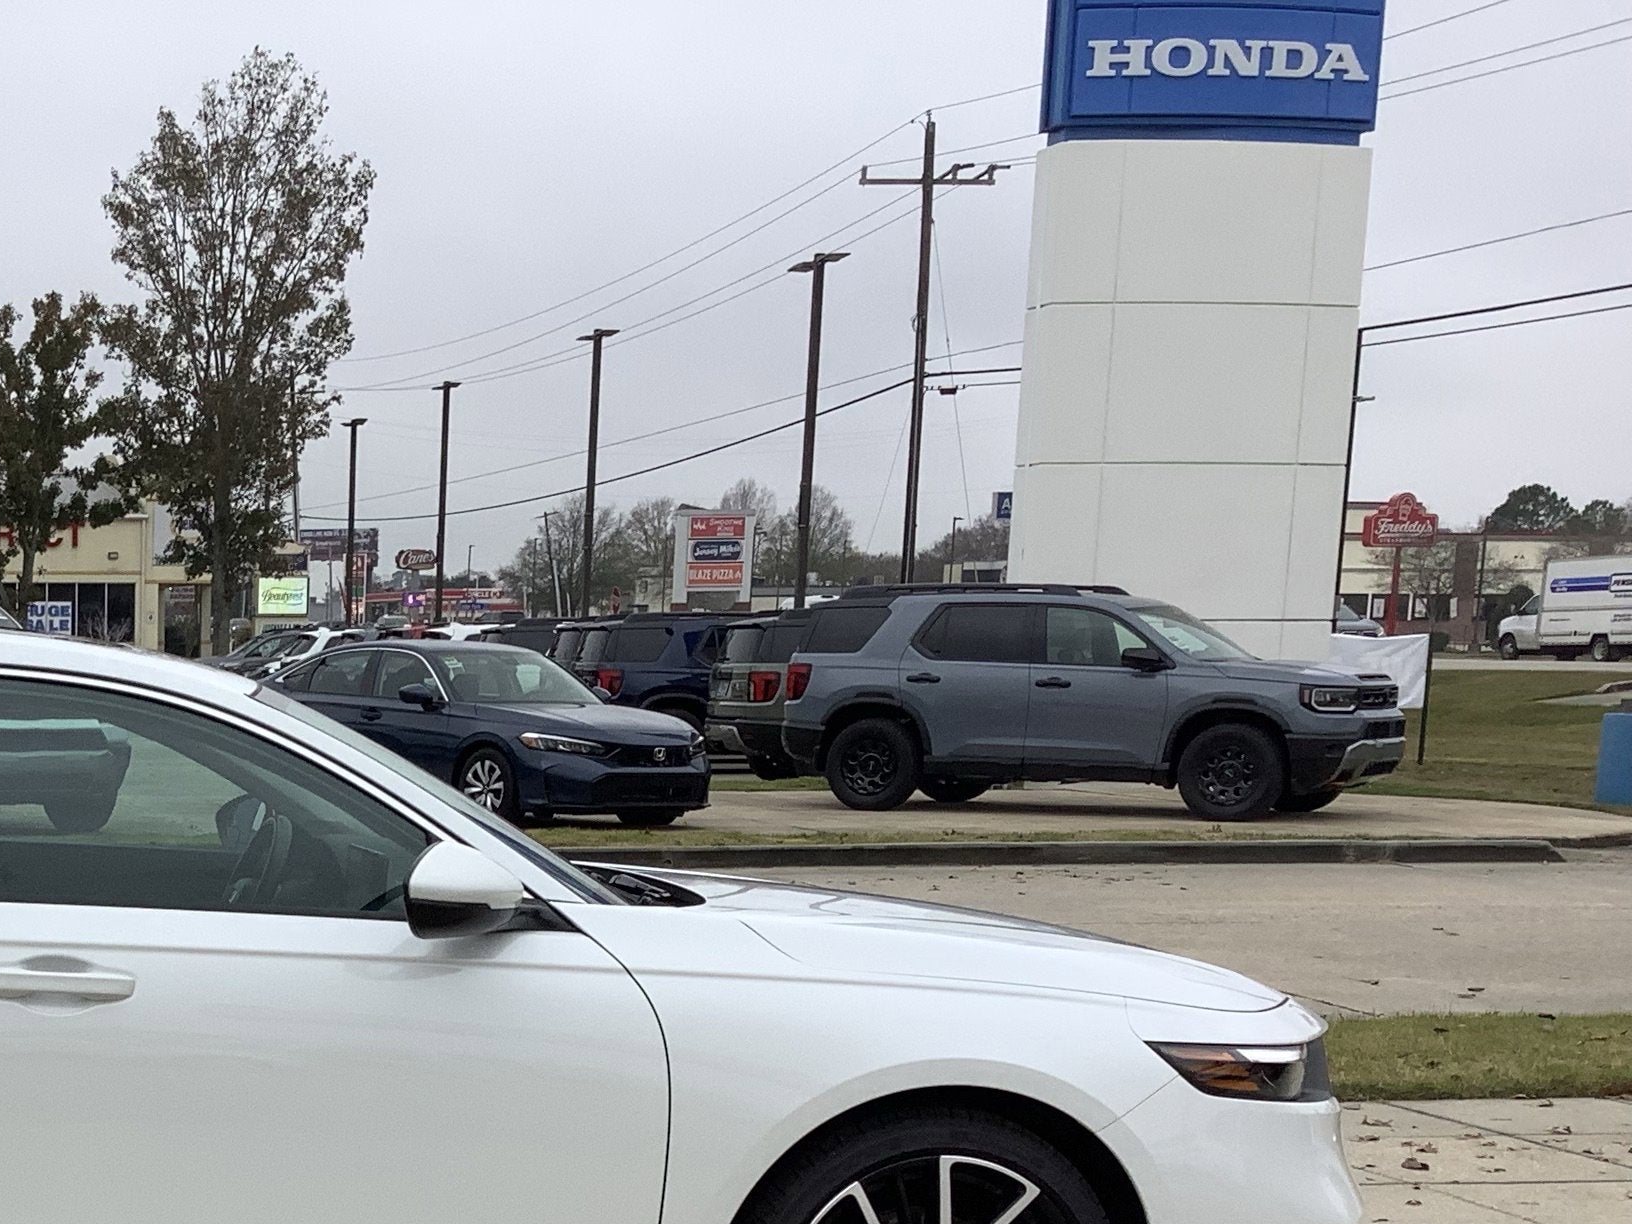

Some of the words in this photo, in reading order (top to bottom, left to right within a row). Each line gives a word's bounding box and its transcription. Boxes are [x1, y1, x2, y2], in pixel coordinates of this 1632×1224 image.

[1085, 37, 1369, 81] HONDA
[1374, 518, 1433, 535] Freddy's
[712, 568, 734, 580] PIZZA
[26, 604, 71, 617] HUGE
[26, 619, 70, 632] SALE
